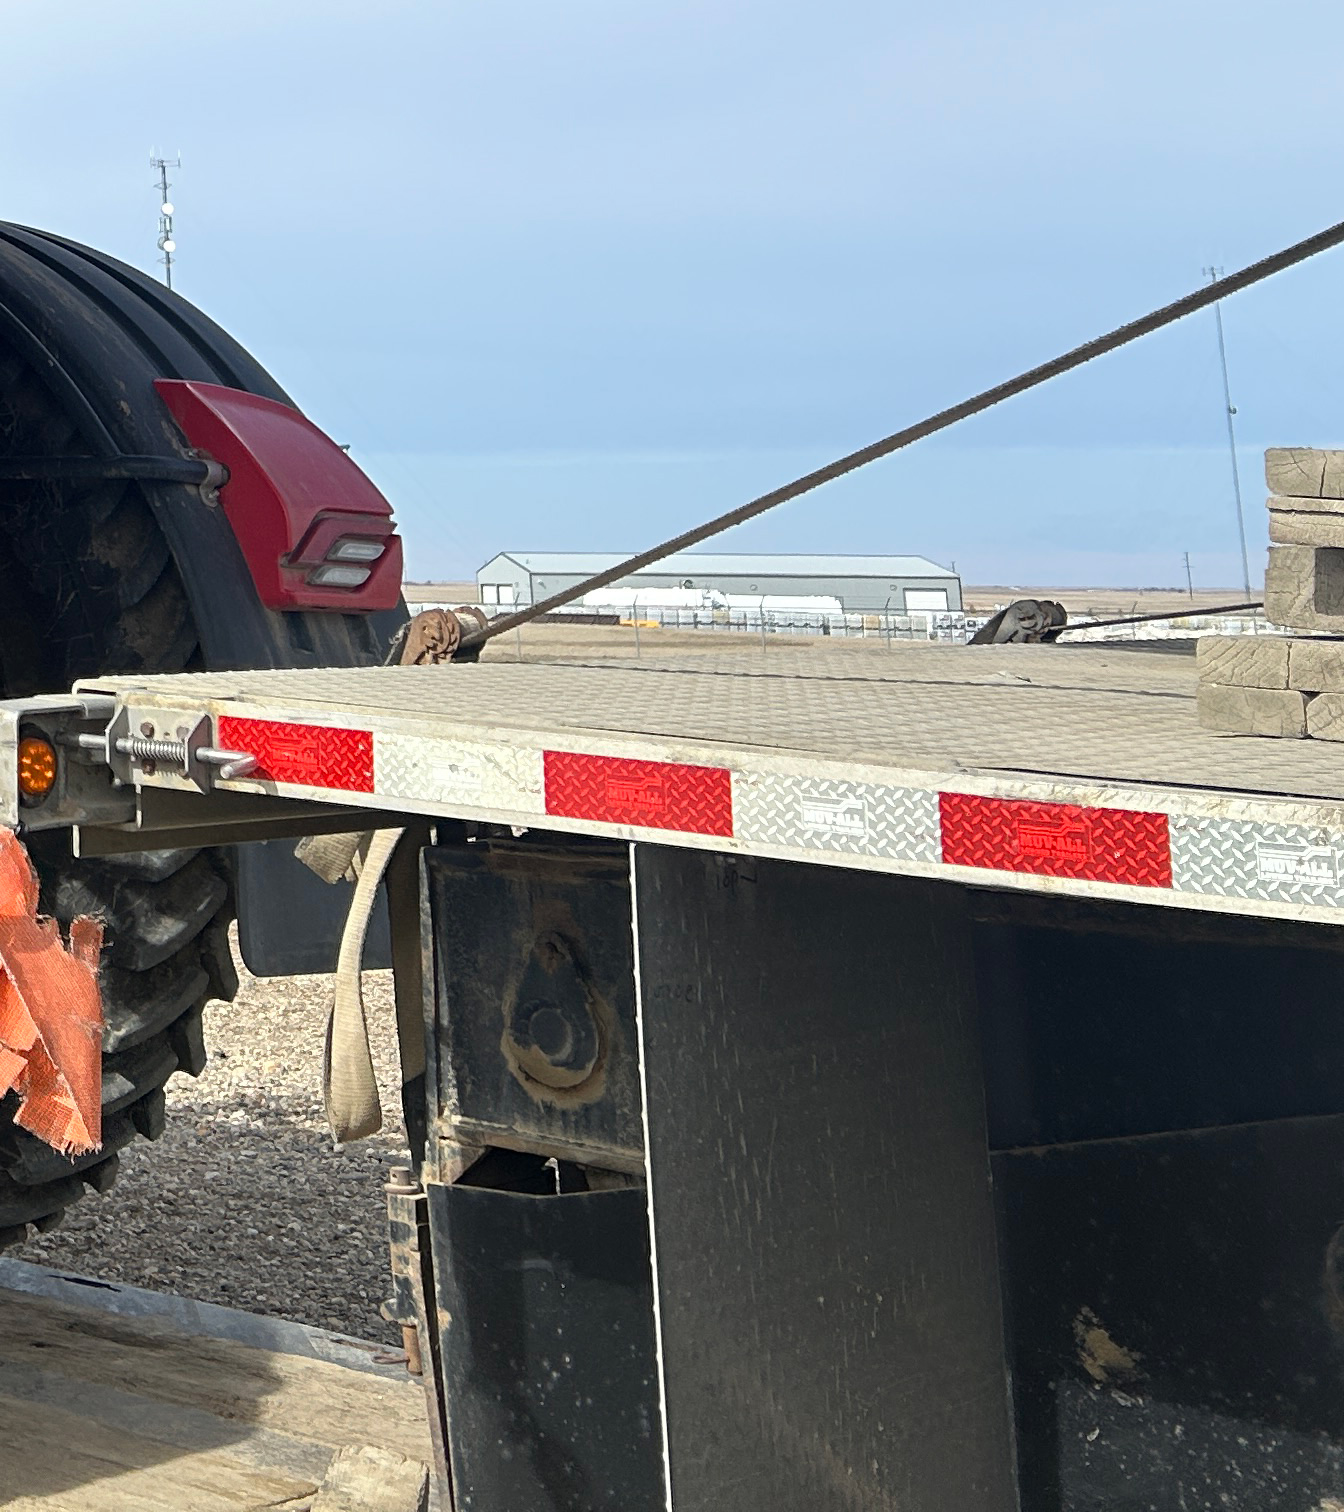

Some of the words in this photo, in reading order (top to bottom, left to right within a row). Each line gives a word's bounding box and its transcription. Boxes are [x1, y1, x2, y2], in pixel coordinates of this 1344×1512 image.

[803, 808, 864, 829] MUV-ALL
[1018, 833, 1087, 854] MUV-ALL
[1260, 857, 1334, 878] MUV-ALL
